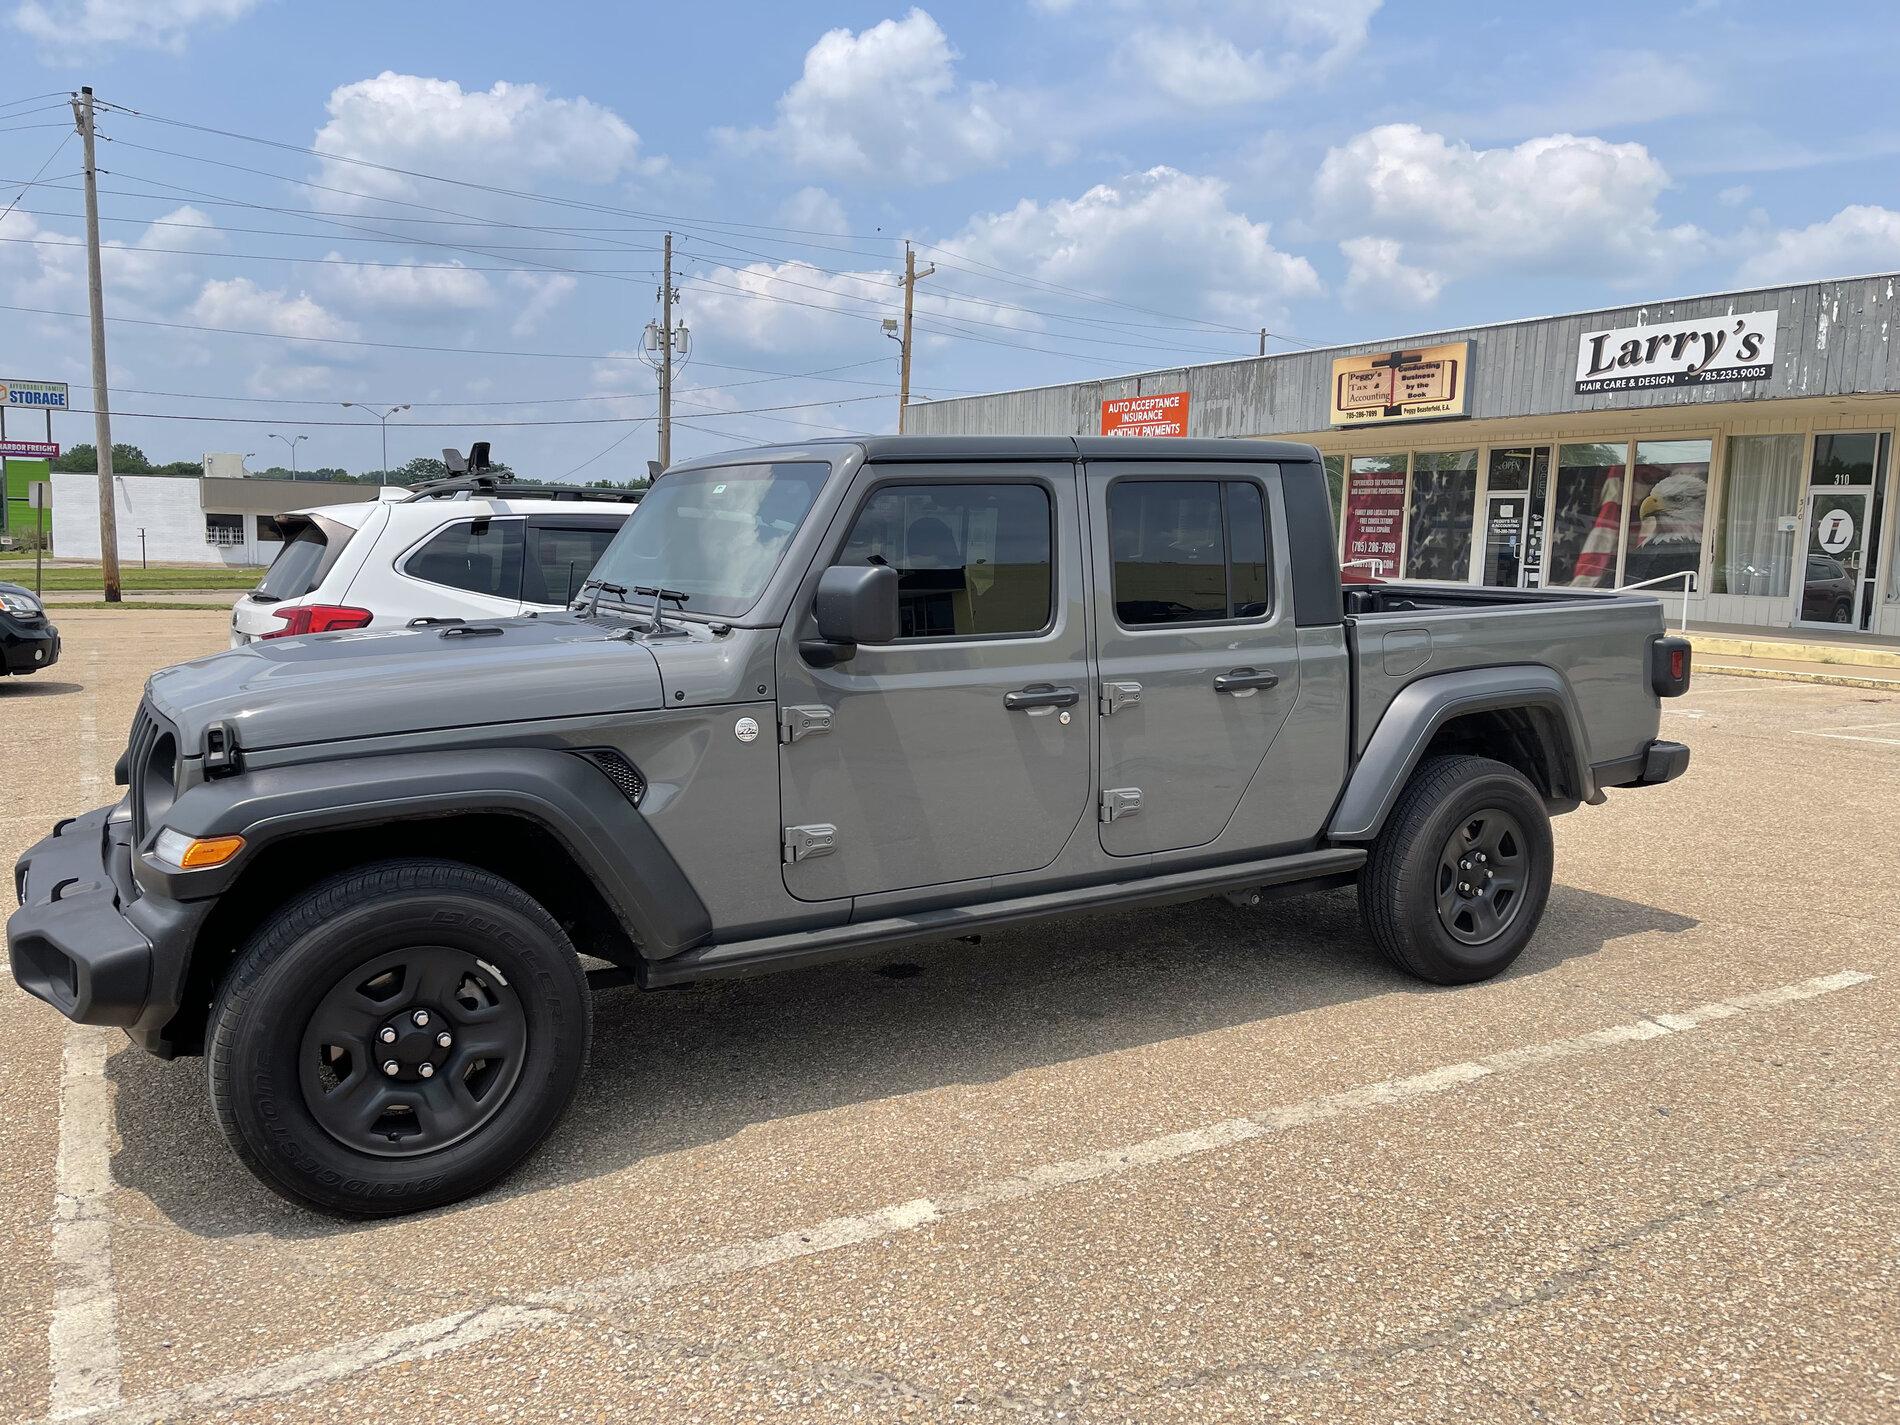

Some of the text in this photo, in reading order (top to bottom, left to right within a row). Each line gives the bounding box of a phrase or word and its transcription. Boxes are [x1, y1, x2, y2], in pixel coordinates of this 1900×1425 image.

[1585, 319, 1765, 378] Larry's
[1398, 363, 1440, 373] Conducting
[1699, 367, 1766, 381] 785.235.9005
[1350, 370, 1382, 382] Peggy's
[1401, 373, 1435, 381] Business
[1349, 383, 1368, 391] Tax
[1406, 383, 1415, 391] by
[1580, 375, 1675, 392] HAIR CARE & DESIGN
[10, 391, 65, 405] STORAGE
[1349, 391, 1390, 403] Accounting
[1109, 396, 1180, 413] AUTO ACCEPTANCE
[1122, 410, 1163, 422] INSURANCE
[1108, 423, 1181, 437] MONTHLY PAYMENTS
[0, 443, 26, 451] HARBOR
[27, 444, 57, 453] FREIGHT
[1834, 474, 1850, 485] 310
